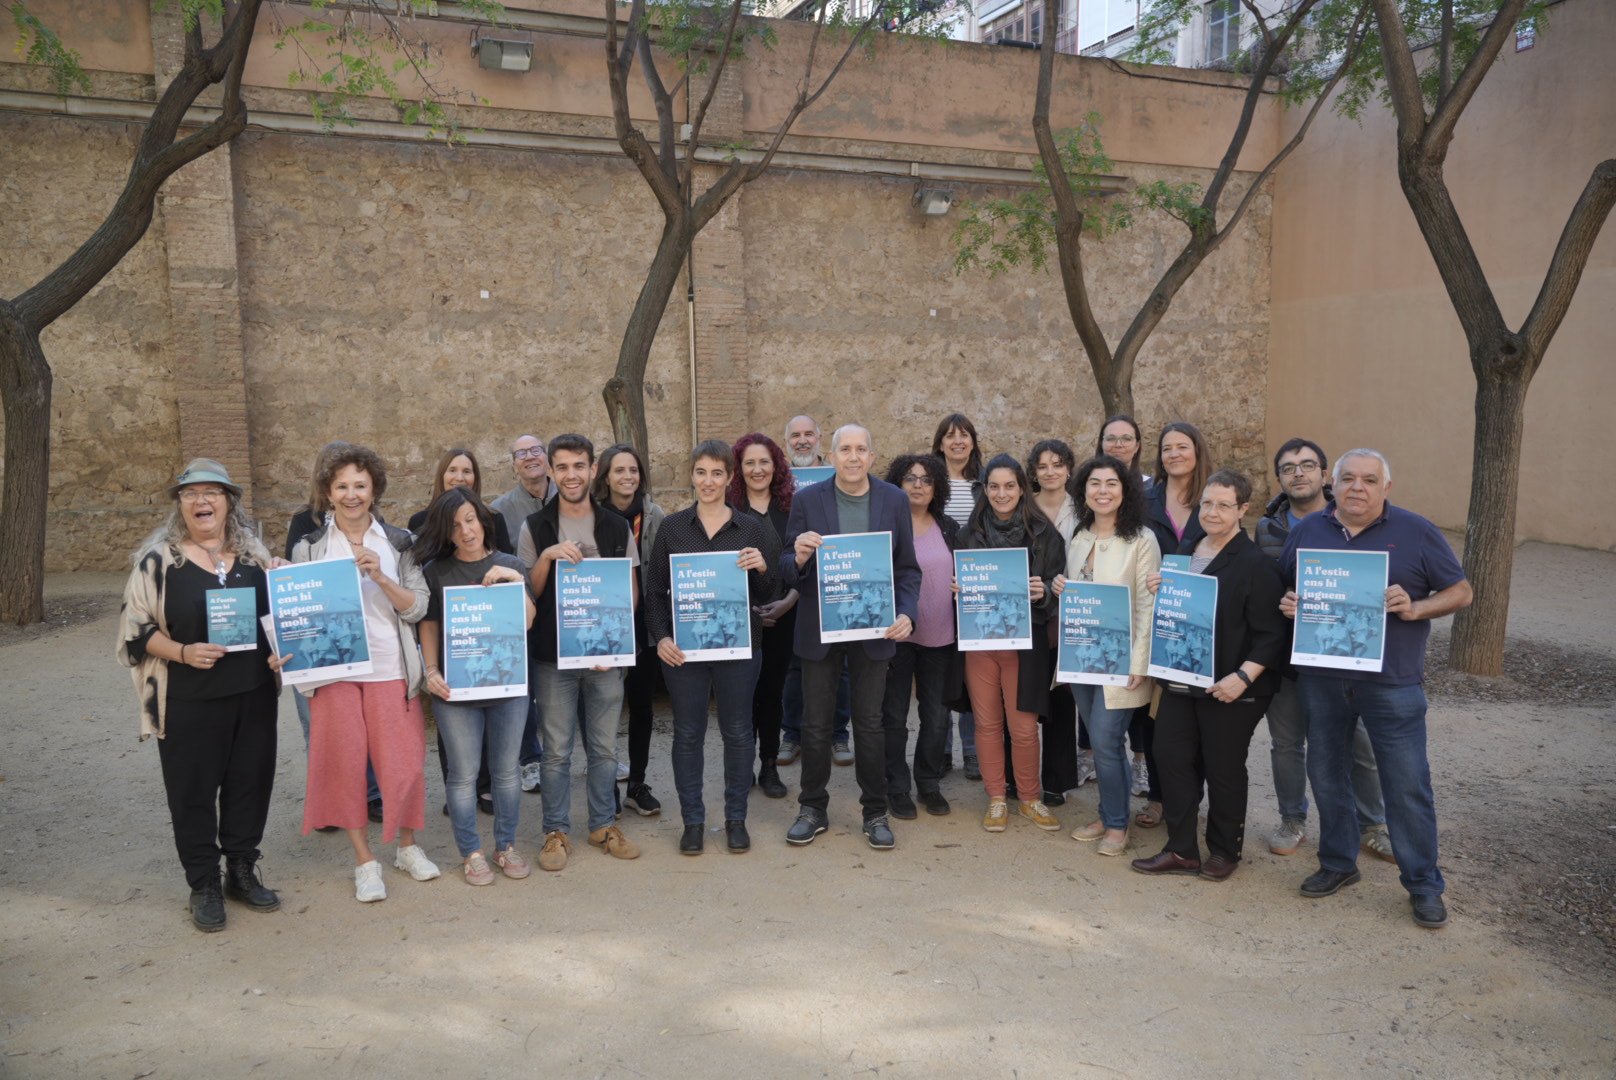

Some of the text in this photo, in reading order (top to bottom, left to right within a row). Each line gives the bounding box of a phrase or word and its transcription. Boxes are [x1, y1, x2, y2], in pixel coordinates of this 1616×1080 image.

[833, 551, 861, 559] l'estiu
[687, 569, 716, 577] l'estiu
[1304, 567, 1349, 576] A l'estiu
[572, 575, 601, 583] l'estiu
[824, 573, 860, 583] juguem
[277, 579, 323, 592] A l'estiu
[697, 580, 706, 588] hi
[825, 583, 848, 592] molt
[1326, 579, 1336, 587] hi
[582, 586, 591, 594] hi
[962, 584, 997, 593] juguem
[1168, 586, 1191, 597] l'estiu
[278, 592, 312, 603] ens hi
[678, 592, 715, 601] juguem
[1303, 590, 1345, 600] juguem
[563, 597, 600, 607] juguem
[1074, 596, 1101, 605] l'estiu
[1159, 598, 1181, 607] ens hi
[279, 603, 323, 618] juguem
[452, 602, 492, 612] A l'estiu
[679, 602, 702, 610] molt
[1157, 607, 1187, 619] juguem
[281, 617, 308, 628] molt
[452, 614, 481, 623] ens hi
[1065, 616, 1099, 625] juguem
[1157, 619, 1175, 628] molt
[451, 626, 490, 636] juguem
[452, 637, 476, 645] molt
